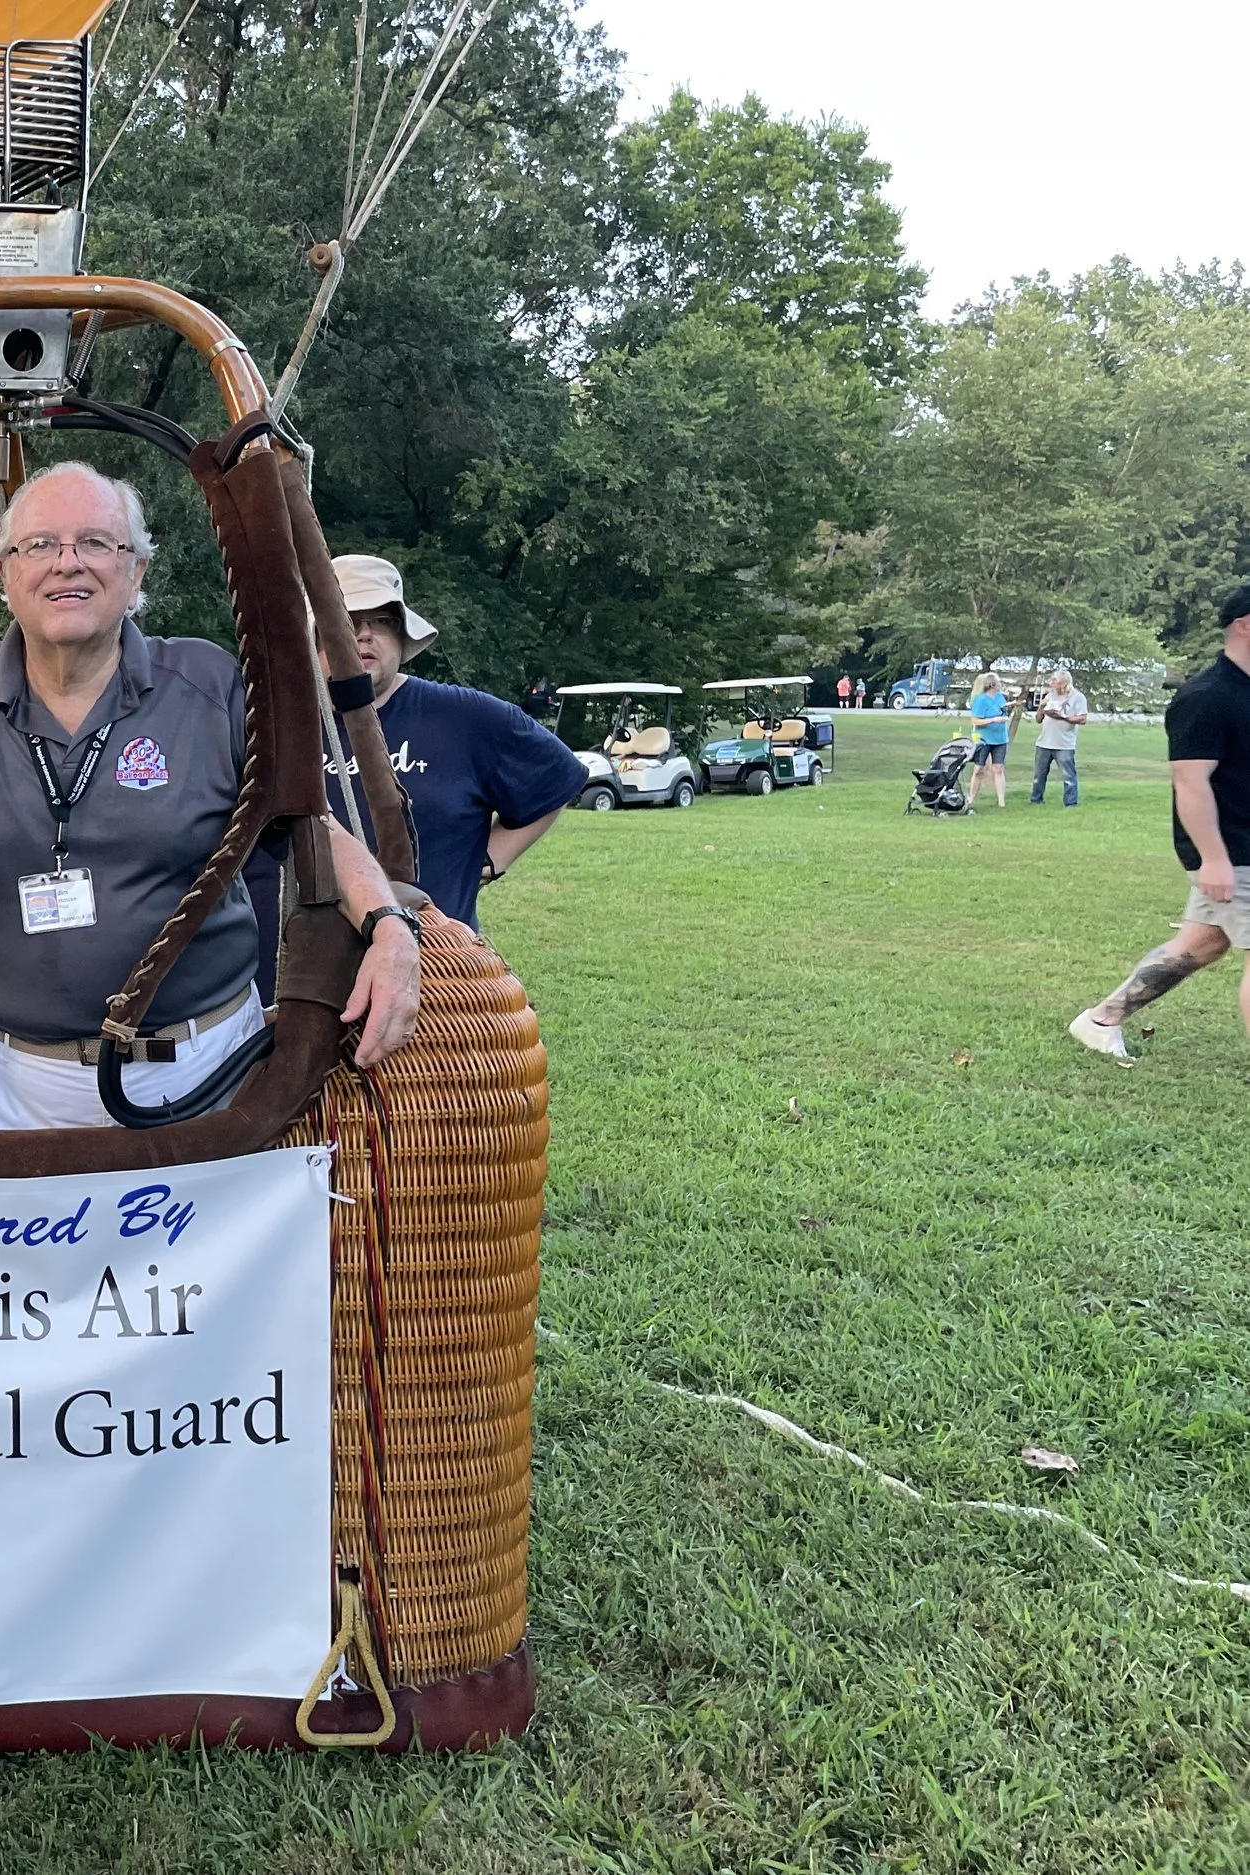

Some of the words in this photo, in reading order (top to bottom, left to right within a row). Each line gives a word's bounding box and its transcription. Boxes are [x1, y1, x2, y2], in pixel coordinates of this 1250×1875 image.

[36, 745, 46, 765] Inspire
[117, 771, 148, 779] Balloon
[117, 1184, 196, 1246] By
[78, 1264, 202, 1338] Air
[55, 1370, 290, 1457] Guard
